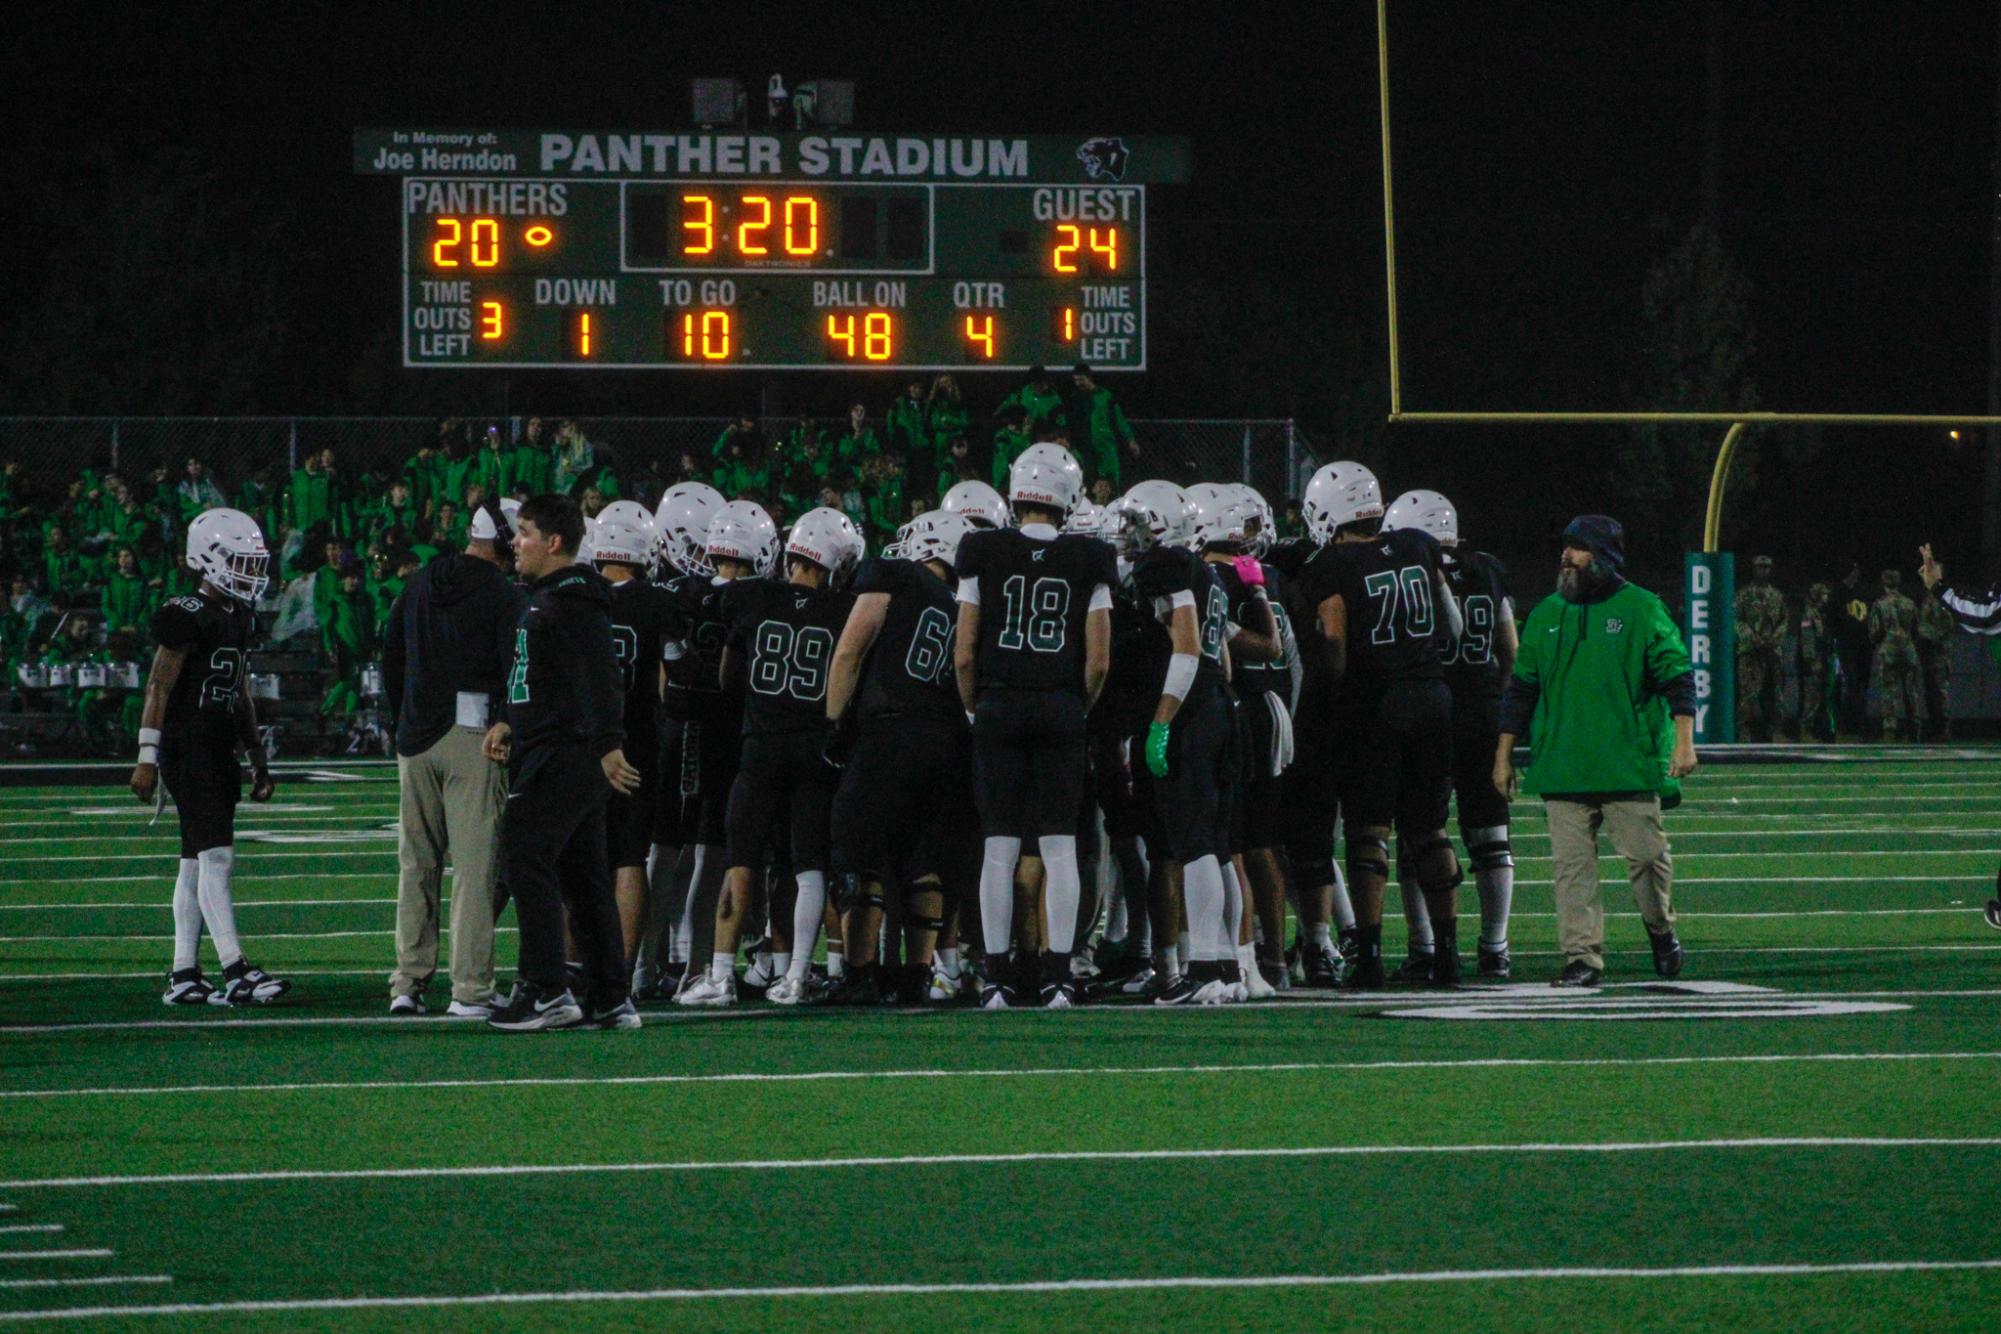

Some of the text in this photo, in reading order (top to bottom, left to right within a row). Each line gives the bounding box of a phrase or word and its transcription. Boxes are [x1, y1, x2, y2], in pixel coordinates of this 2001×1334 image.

[393, 131, 409, 145] In
[413, 132, 473, 147] Memory
[373, 148, 517, 171] Joe Herndon
[540, 133, 1029, 177] PANTHER STADIUM
[407, 182, 568, 216] PANTHERS
[1033, 189, 1136, 221] GUEST
[433, 218, 499, 267] 20
[1053, 225, 1117, 272] 24
[421, 281, 471, 302] TIME
[535, 279, 616, 306] DOWN
[659, 279, 736, 305] TO GO
[813, 281, 906, 307] BALL ON
[953, 282, 1005, 308] QTR
[1081, 286, 1130, 307] TIME
[414, 307, 471, 330] OUTS
[482, 302, 502, 339] 3
[1065, 308, 1072, 340] 1
[1080, 312, 1136, 334] OUTS
[419, 334, 471, 356] LEFT
[582, 313, 589, 355] 1
[684, 312, 730, 359] 10
[828, 313, 891, 360] 48
[966, 315, 993, 357] 4
[1081, 338, 1130, 360] LEFT
[1017, 491, 1053, 502] Riddell
[596, 551, 631, 561] Riddell
[708, 545, 739, 557] Riddell
[790, 543, 821, 561] Riddell
[998, 575, 1071, 652] 18
[1364, 565, 1435, 645] 70
[905, 605, 953, 685] 6
[1691, 565, 1713, 733] DERBY
[750, 619, 834, 701] 89
